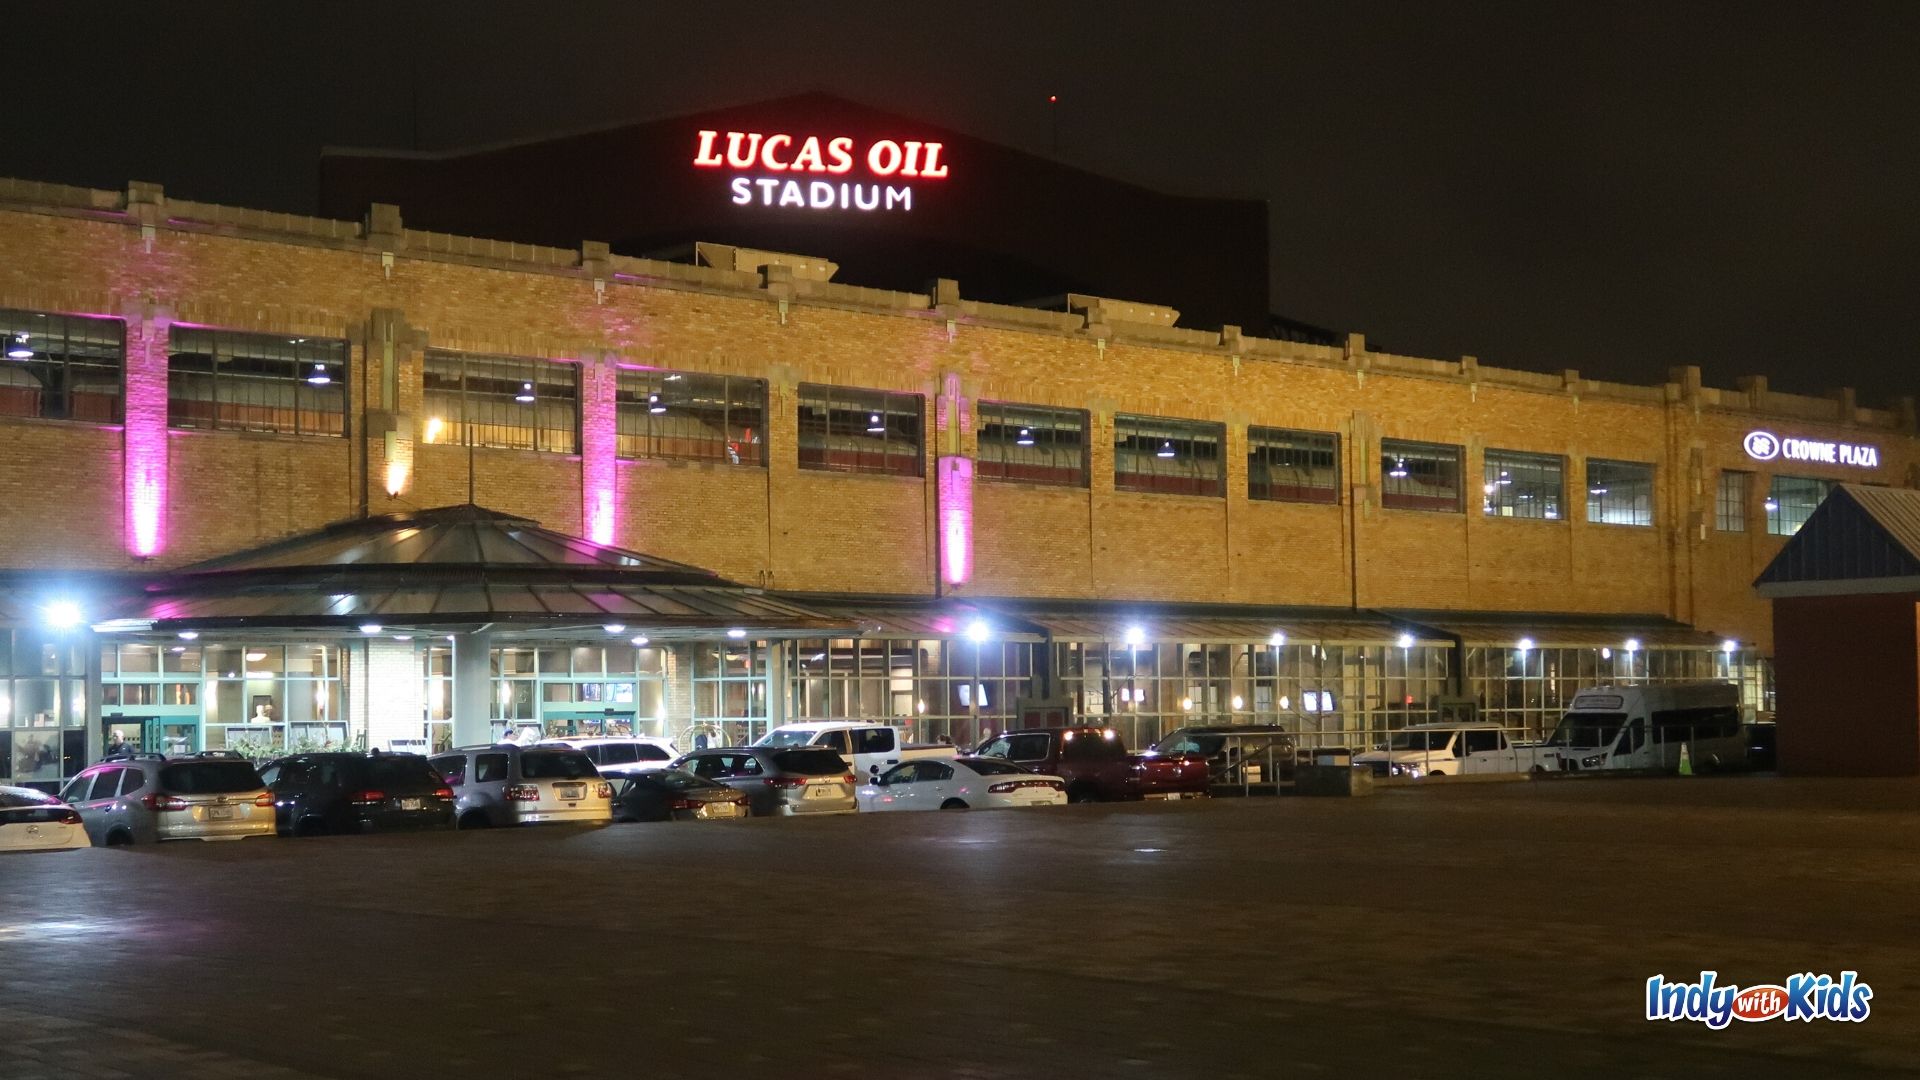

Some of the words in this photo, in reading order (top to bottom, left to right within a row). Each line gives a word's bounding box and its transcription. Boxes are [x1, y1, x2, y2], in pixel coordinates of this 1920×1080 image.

[693, 130, 853, 172] LUCAS
[867, 139, 948, 177] OIL
[731, 177, 912, 210] STADIUM
[1782, 438, 1837, 463] CROWNE
[1839, 444, 1878, 467] PLAZA
